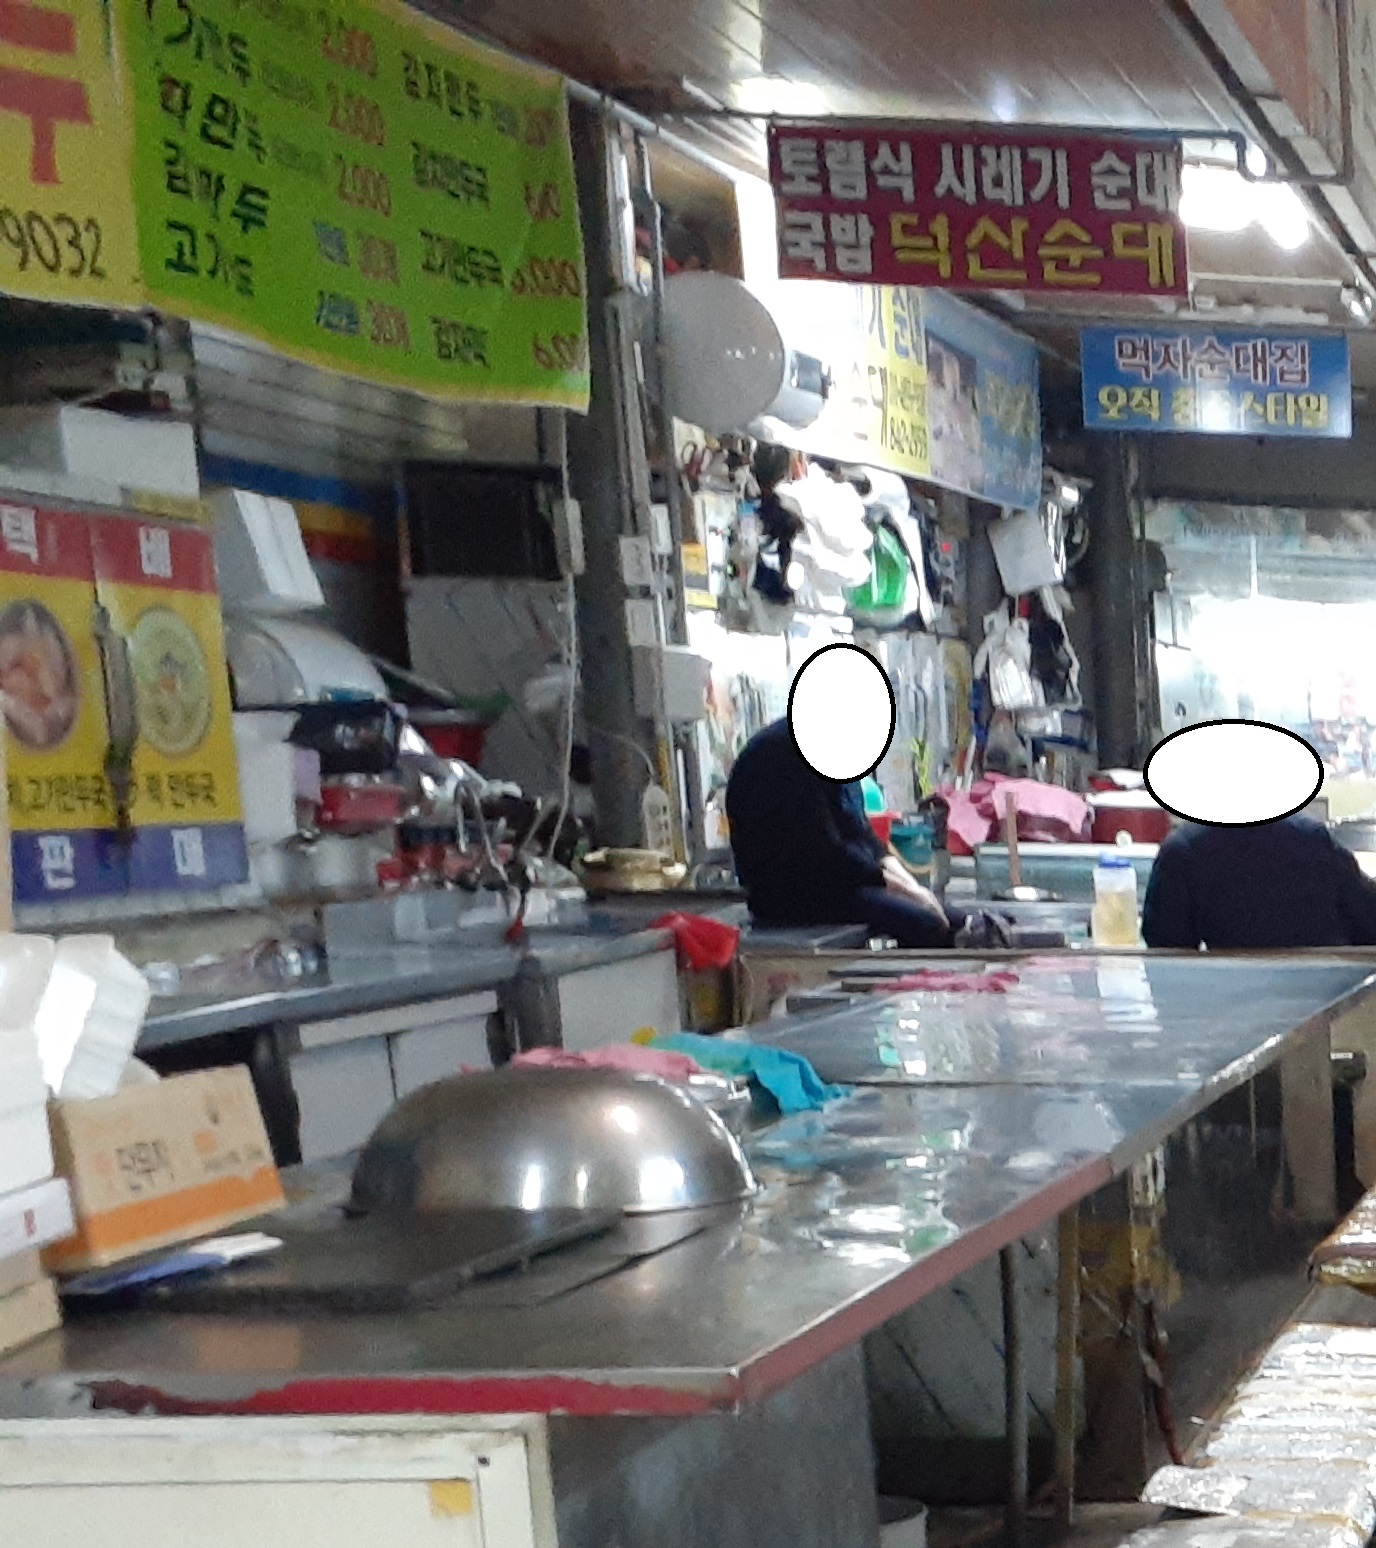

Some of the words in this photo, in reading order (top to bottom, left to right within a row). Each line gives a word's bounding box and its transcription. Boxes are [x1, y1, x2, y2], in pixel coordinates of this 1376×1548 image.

[1091, 149, 1180, 215] 순대
[784, 209, 875, 274] 국밥
[889, 211, 1177, 288] 덕산순대
[1115, 336, 1310, 388] 먹자순대집
